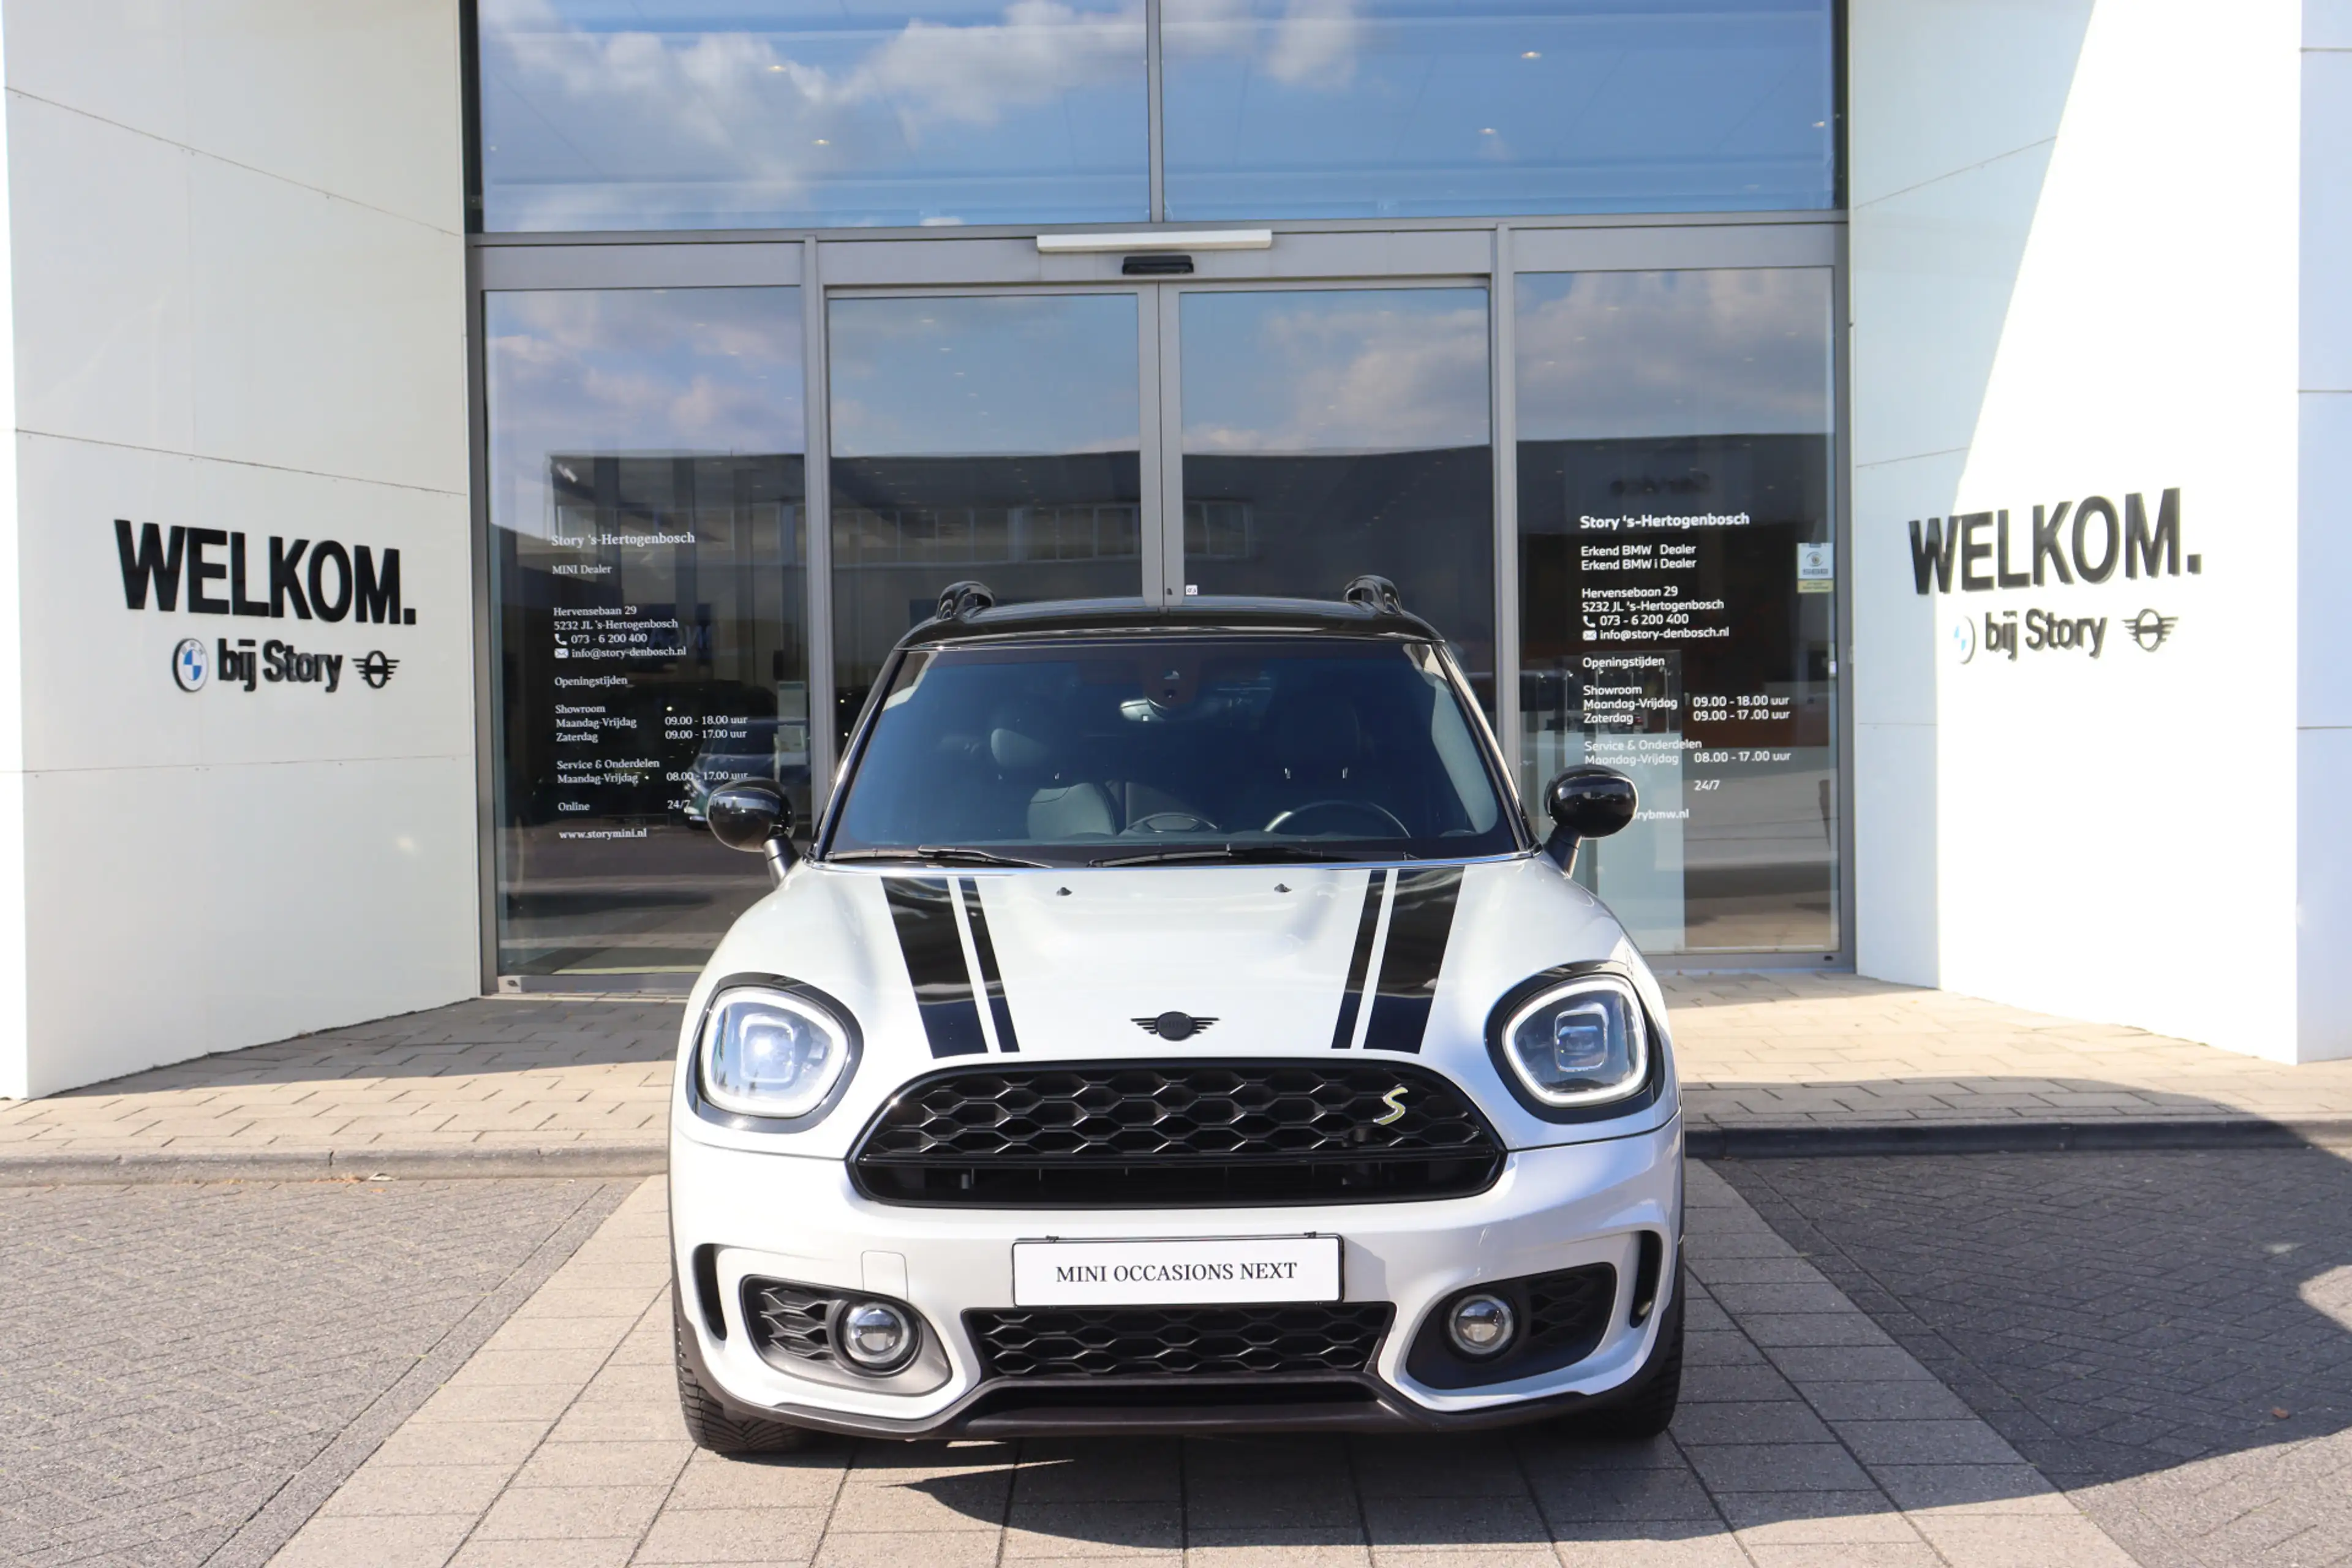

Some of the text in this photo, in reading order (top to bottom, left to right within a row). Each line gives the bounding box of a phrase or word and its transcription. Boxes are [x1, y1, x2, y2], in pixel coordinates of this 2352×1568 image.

[1580, 516, 1619, 530] Story
[551, 535, 584, 548] Story
[1909, 487, 2202, 595] WELKOM.
[1581, 543, 1696, 556] Erkend BMW Dealer
[552, 565, 612, 574] MINI Dealer
[1581, 558, 1696, 570] Erkend BMW i Dealer
[113, 519, 417, 625] WELKOM.
[1582, 586, 1678, 598] Hervensebaan 29
[554, 606, 637, 616] Hervensebaan 29
[1583, 602, 1609, 612] 5232
[1611, 601, 1624, 612] JL
[554, 621, 578, 630] 5232
[580, 620, 593, 630] JL
[1599, 615, 1620, 625] 073
[1631, 614, 1638, 625] 6
[1642, 614, 1663, 625] 200
[1666, 614, 1689, 624] 400
[571, 635, 589, 643] 073
[599, 634, 605, 643] 6
[608, 634, 627, 643] 200
[628, 633, 647, 643] 400
[1600, 627, 1729, 641] info@story-denbosch.nl
[1986, 608, 2108, 662] bij Story
[572, 647, 686, 660] info@story-denbosch.nl
[218, 638, 342, 692] bij Story
[1583, 657, 1665, 669] Openingstijden
[555, 676, 627, 688] Openingstijden
[1583, 685, 1642, 696] Showroom
[556, 705, 605, 714] Showroom
[1584, 698, 1678, 710] Maandag-Vrijdag
[1693, 696, 1727, 707] 09.00
[1736, 696, 1768, 706] 18.00
[1771, 696, 1790, 706] uur
[556, 718, 636, 729] Maandag-Vrijdag
[665, 717, 692, 725] 09.00
[702, 716, 728, 725] 18.00
[1584, 713, 1634, 725] Zaterdag
[1693, 710, 1727, 721] 09.00
[1737, 710, 1768, 720] 17.00
[1772, 710, 1790, 720] uur
[556, 732, 598, 743] Zaterdag
[665, 730, 692, 739] 09.00
[703, 730, 728, 739] 17.00
[1585, 739, 1702, 752] Service & Onderdelen
[557, 760, 592, 769] Service
[605, 759, 660, 768] Onderdelen
[1585, 753, 1679, 766] Maandag-Vrijdag
[1694, 752, 1728, 763] 08.00
[1739, 752, 1770, 762] 17.00
[1773, 752, 1791, 761] uur
[557, 774, 638, 785] Maandag-Vrijdag
[666, 772, 693, 781] 08.00
[1695, 780, 1720, 791] 24/7
[558, 801, 690, 811] Online 24/7
[559, 828, 647, 840] www.storymini.nl
[1373, 1085, 1408, 1125] S
[1056, 1262, 1297, 1282] MINI OCCASIONS NEXT
